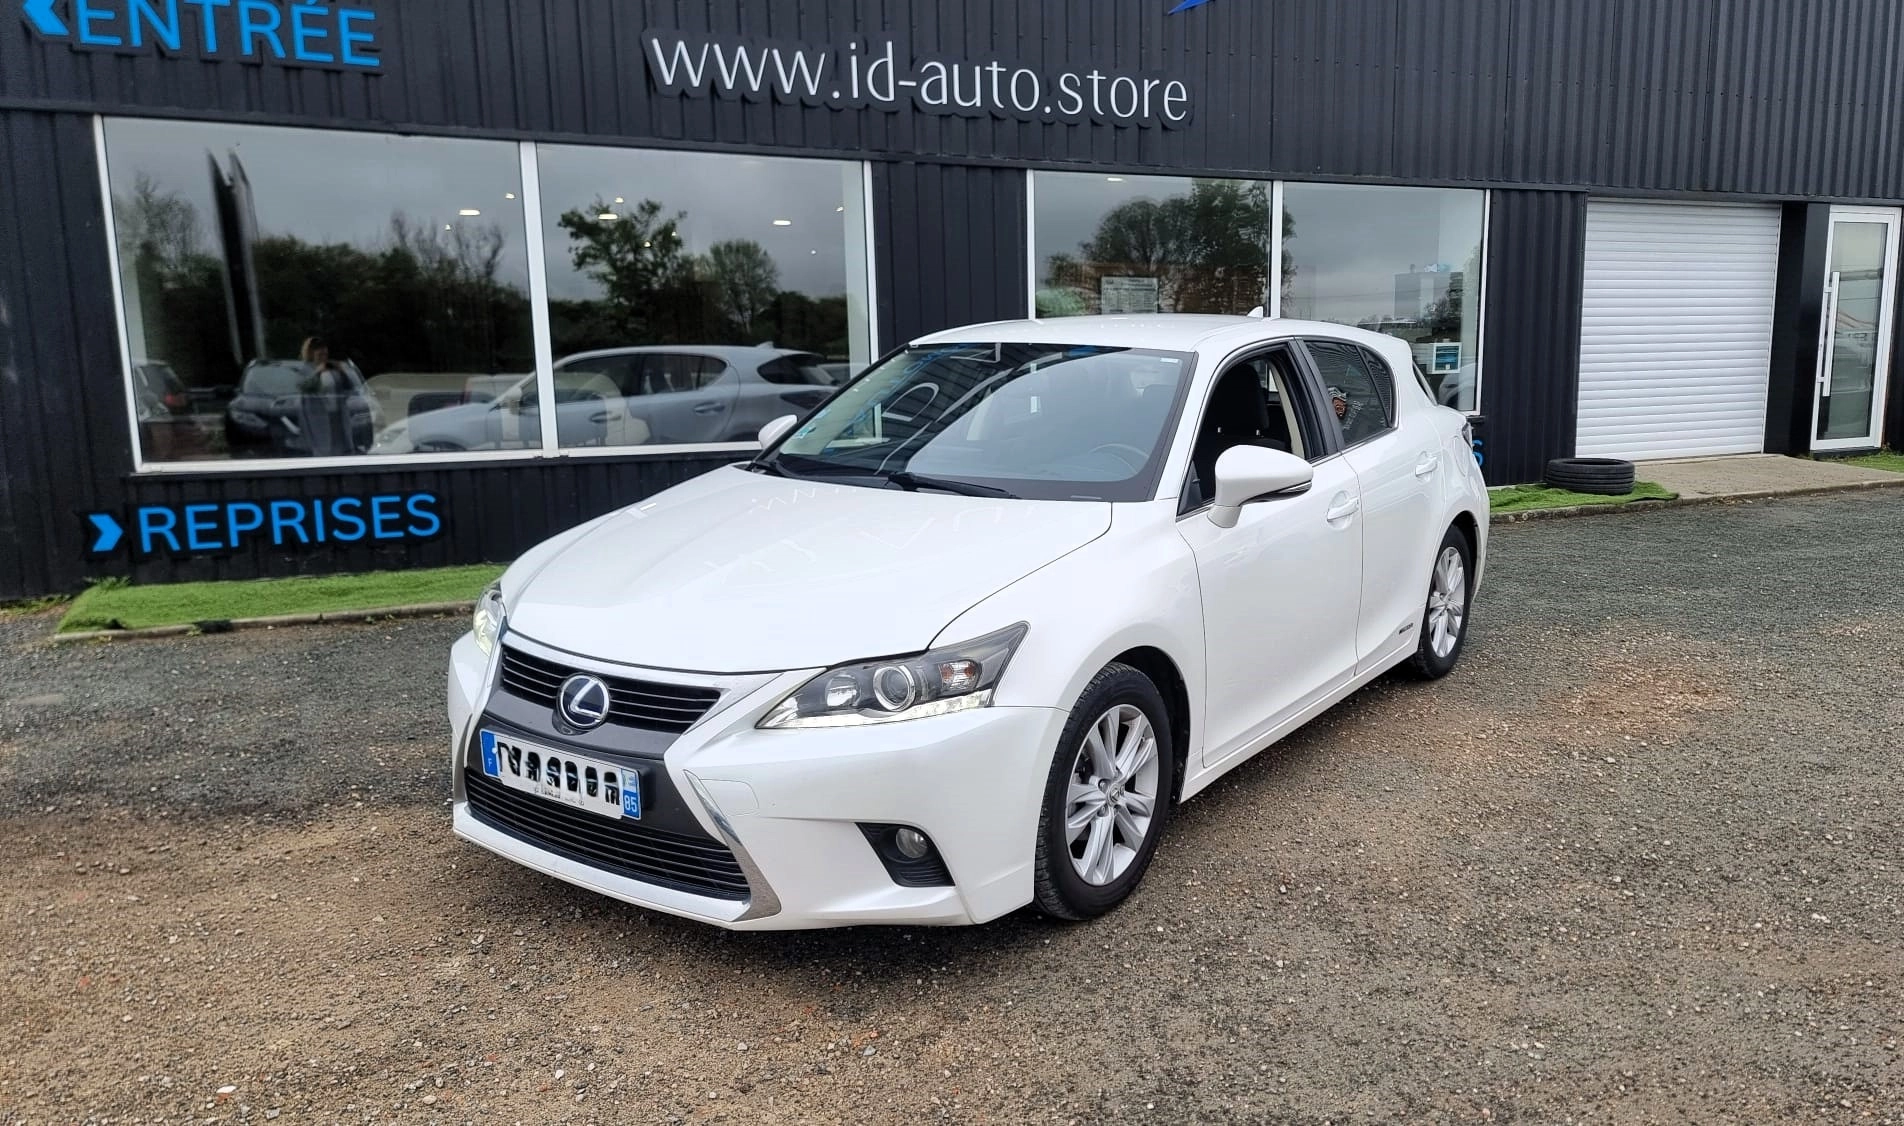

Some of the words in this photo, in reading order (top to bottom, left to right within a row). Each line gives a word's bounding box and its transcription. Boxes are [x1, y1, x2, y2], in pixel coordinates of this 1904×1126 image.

[76, 0, 380, 66] ENTRÉE
[650, 38, 1188, 122] www.id-auto.store
[139, 494, 440, 552] REPRISES
[624, 794, 638, 813] 85
